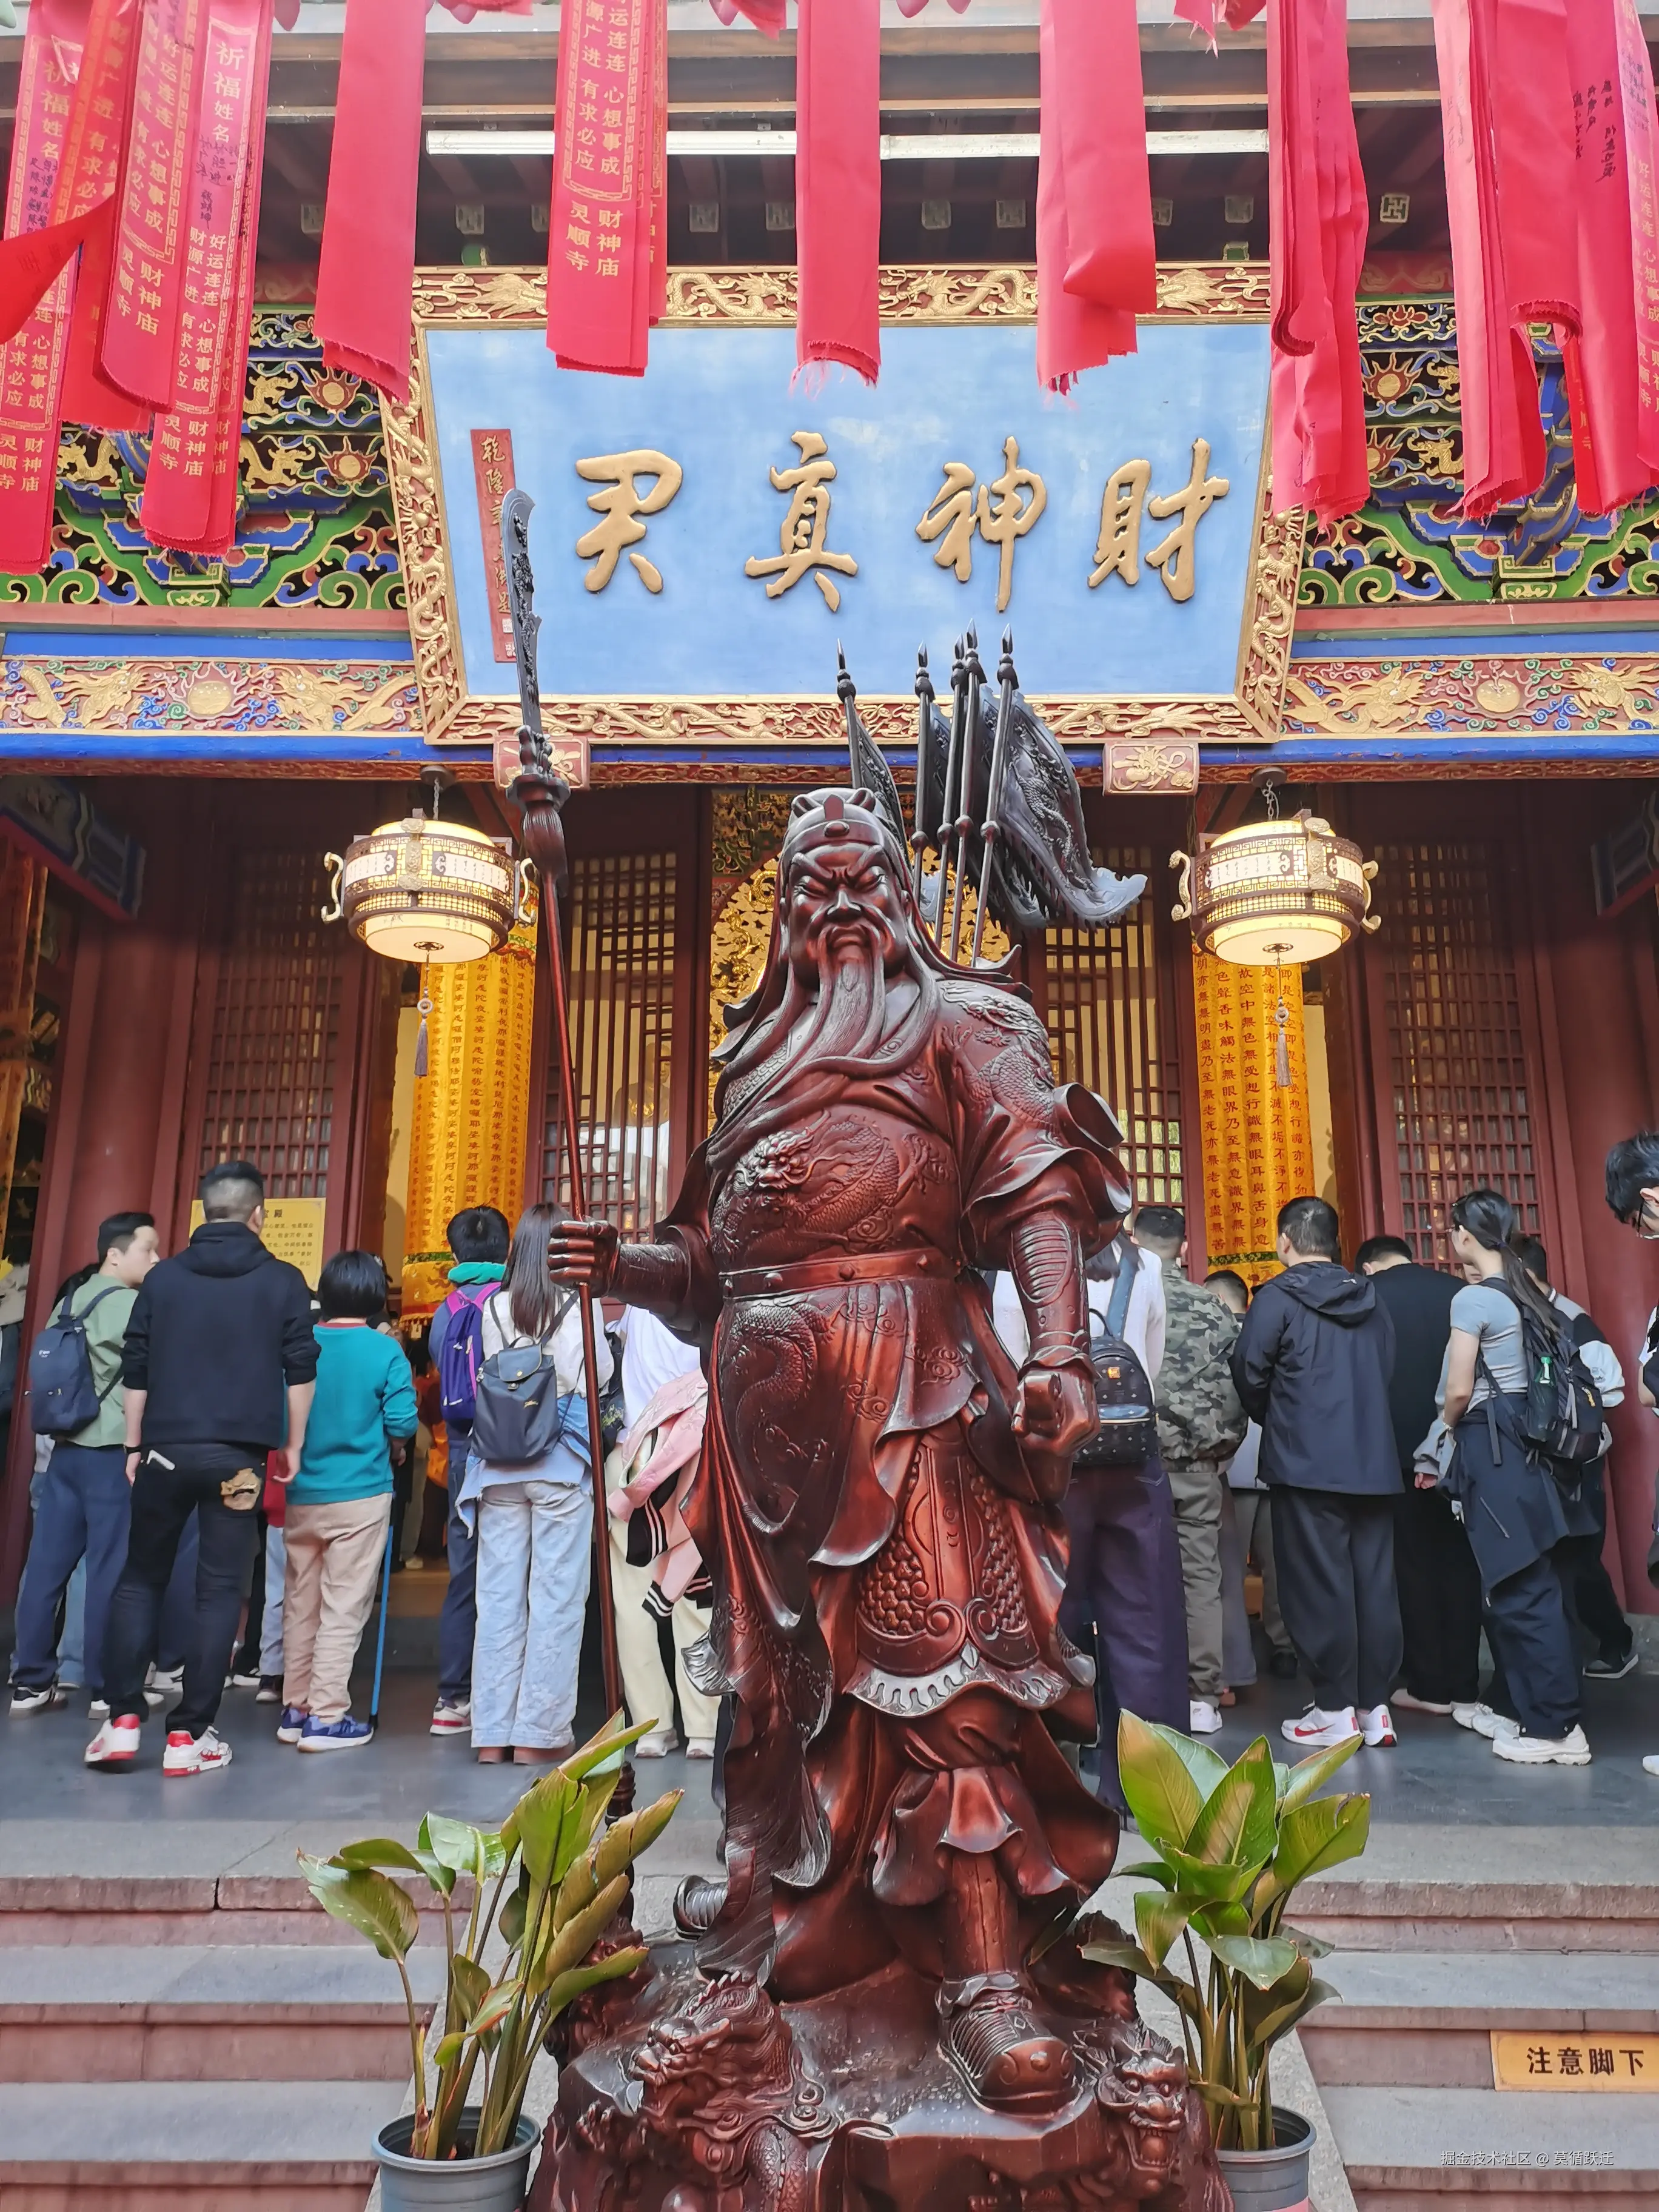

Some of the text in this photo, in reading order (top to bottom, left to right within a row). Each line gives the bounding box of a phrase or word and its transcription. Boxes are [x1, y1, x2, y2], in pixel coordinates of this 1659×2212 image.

[212, 41, 244, 144] 祈福姓名
[574, 78, 600, 172] 有求必应
[600, 0, 629, 176] 运连连 心想事成
[126, 122, 151, 218] 有求必应
[144, 139, 171, 234] 心想事成
[1638, 159, 1655, 238] 好运连连
[184, 227, 207, 303] 财源广进
[201, 233, 227, 307] 好运连连
[565, 200, 592, 272] 灵顺寺
[595, 209, 623, 277] 财神庙
[116, 244, 136, 317] 灵顺寺
[135, 261, 165, 335] 财神庙
[5, 330, 30, 406] 有求必应
[28, 334, 51, 411] 心想事成
[192, 319, 216, 394] 心想事成
[0, 433, 19, 491] 灵顺寺
[21, 437, 45, 492] 财神庙
[159, 414, 183, 471] 灵顺寺
[184, 420, 210, 477] 财神庙
[1526, 2046, 1644, 2077] 注意脚下
